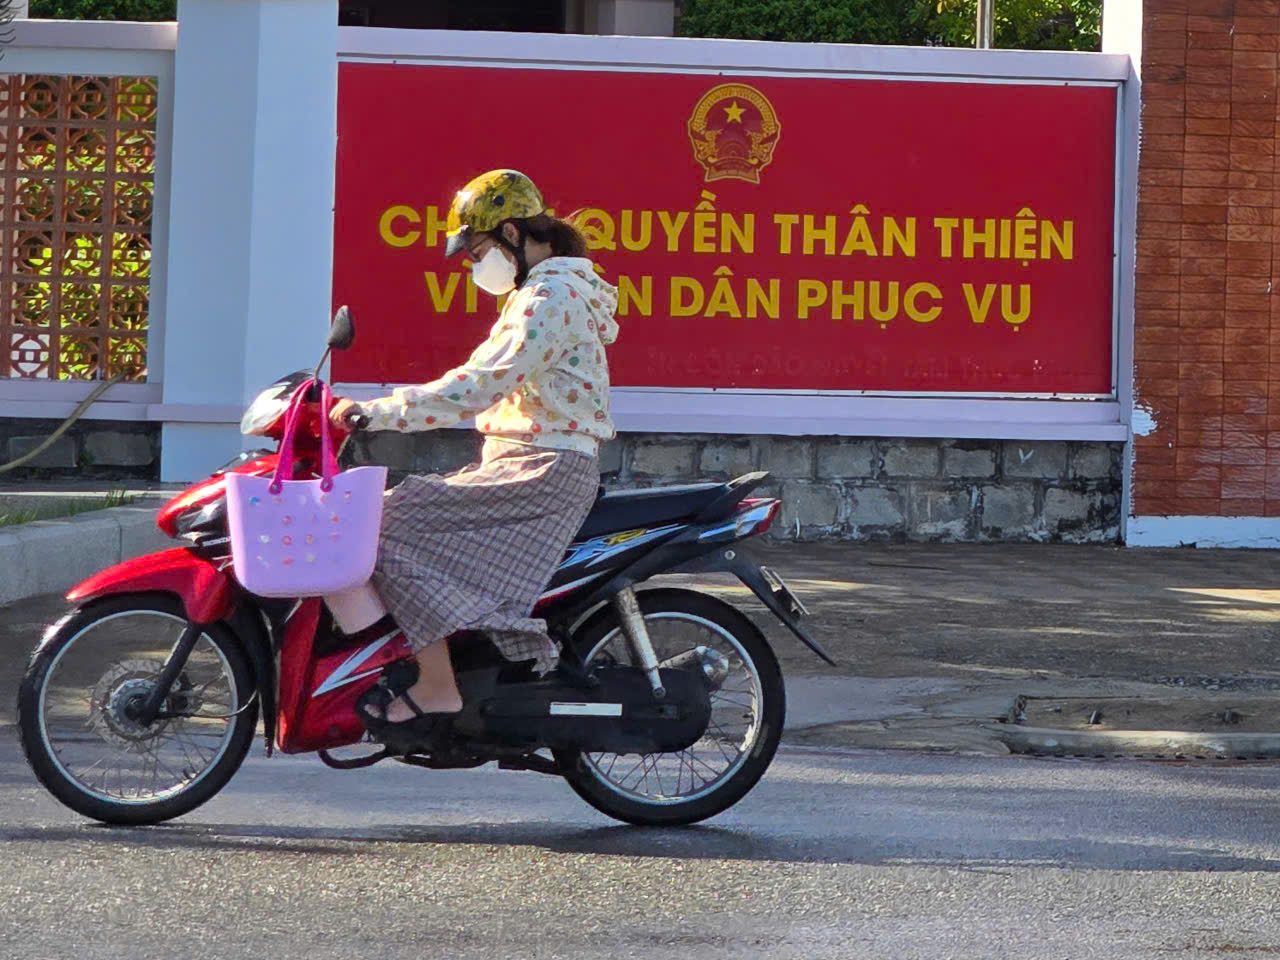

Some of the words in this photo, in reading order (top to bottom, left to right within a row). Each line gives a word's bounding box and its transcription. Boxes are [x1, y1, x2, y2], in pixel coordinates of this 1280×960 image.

[573, 189, 755, 254] QUYỀN
[773, 204, 917, 257] THÂN
[933, 207, 1074, 267] THIỆN
[424, 258, 478, 313] VÌ
[669, 265, 780, 318] DÂN
[797, 279, 943, 329] PHỤC
[962, 283, 1031, 332] VỤ
